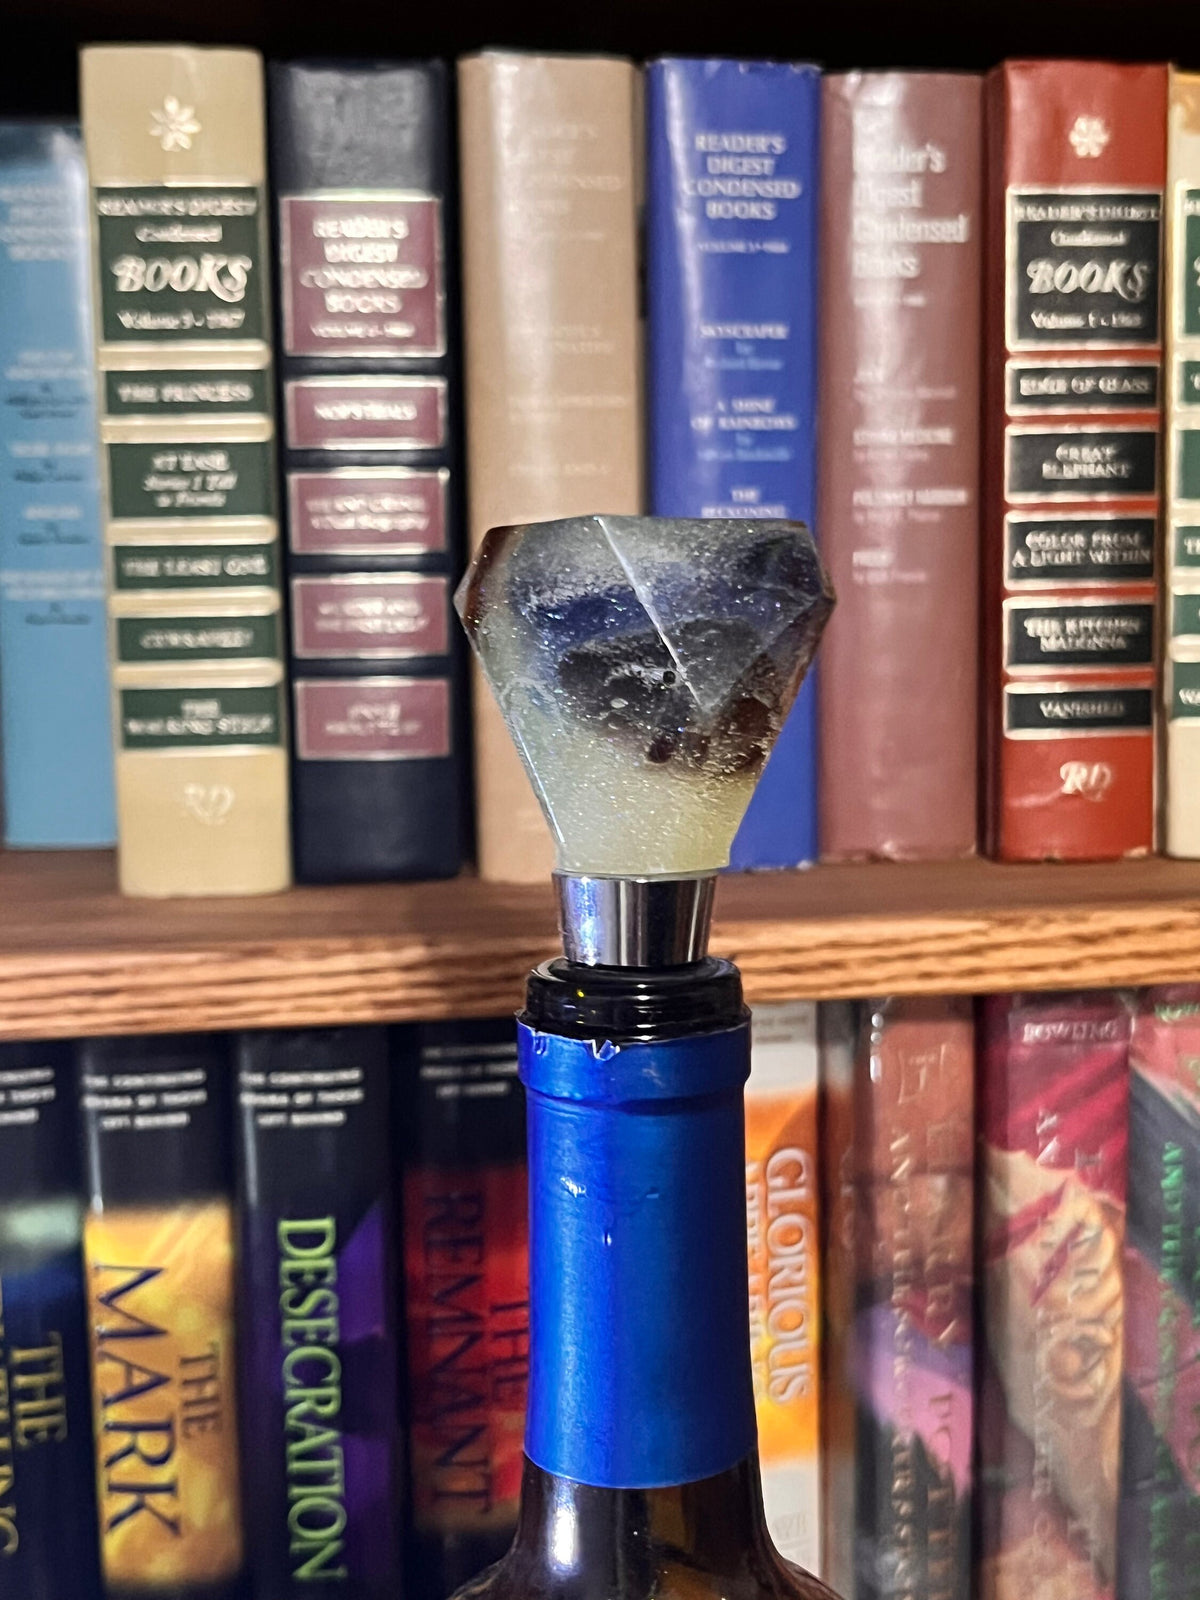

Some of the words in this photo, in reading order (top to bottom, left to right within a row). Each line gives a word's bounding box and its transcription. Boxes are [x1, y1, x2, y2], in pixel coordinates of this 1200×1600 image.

[695, 133, 786, 155] READER'S
[706, 155, 776, 176] DIGEST
[685, 178, 801, 199] CONDENSED
[705, 201, 778, 220] BOOKS
[111, 253, 253, 303] BOOKS
[1026, 259, 1149, 303] BOOKS
[1012, 550, 1027, 568] A
[766, 1147, 809, 1405] GLORIOUS
[424, 1193, 489, 1514] REMNANT
[490, 1298, 530, 1403] THE
[11, 1331, 68, 1447] THE
[94, 1263, 183, 1538] MARK
[179, 1339, 223, 1440] THE
[277, 1215, 348, 1582] DESECRATION
